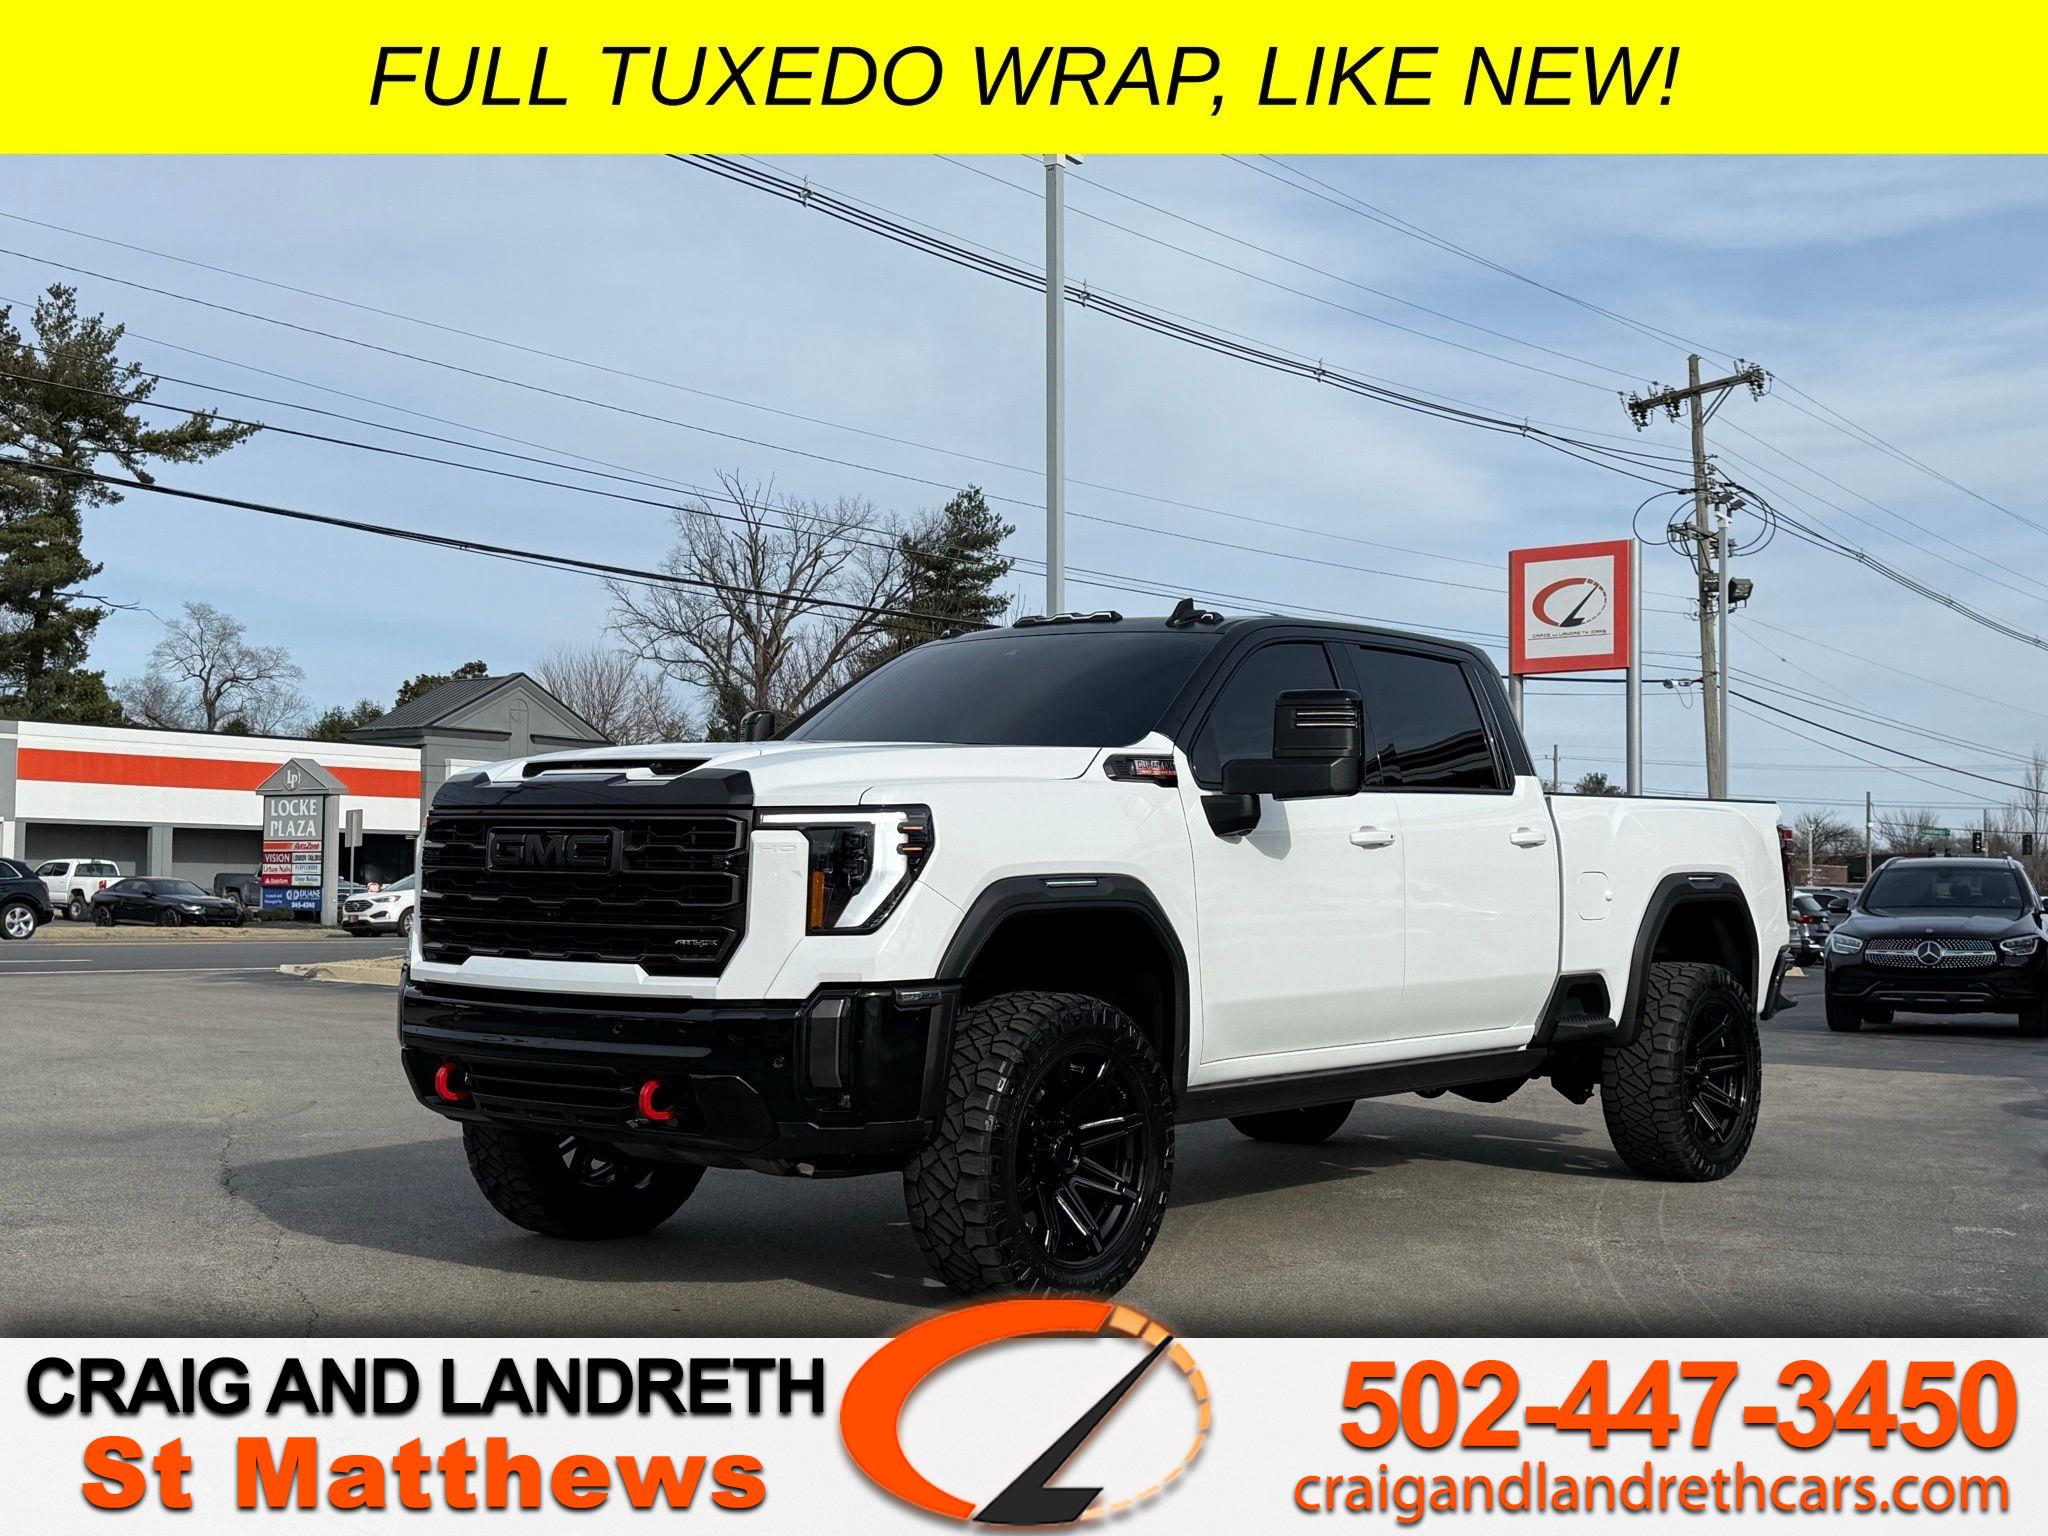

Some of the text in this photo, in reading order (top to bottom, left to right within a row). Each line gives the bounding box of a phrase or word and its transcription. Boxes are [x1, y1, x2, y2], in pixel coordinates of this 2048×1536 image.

[270, 799, 317, 817] LOCKE
[270, 820, 317, 837] PLAZA
[293, 842, 320, 850] AutoZone
[491, 834, 608, 867] GMC
[264, 853, 290, 863] VISION
